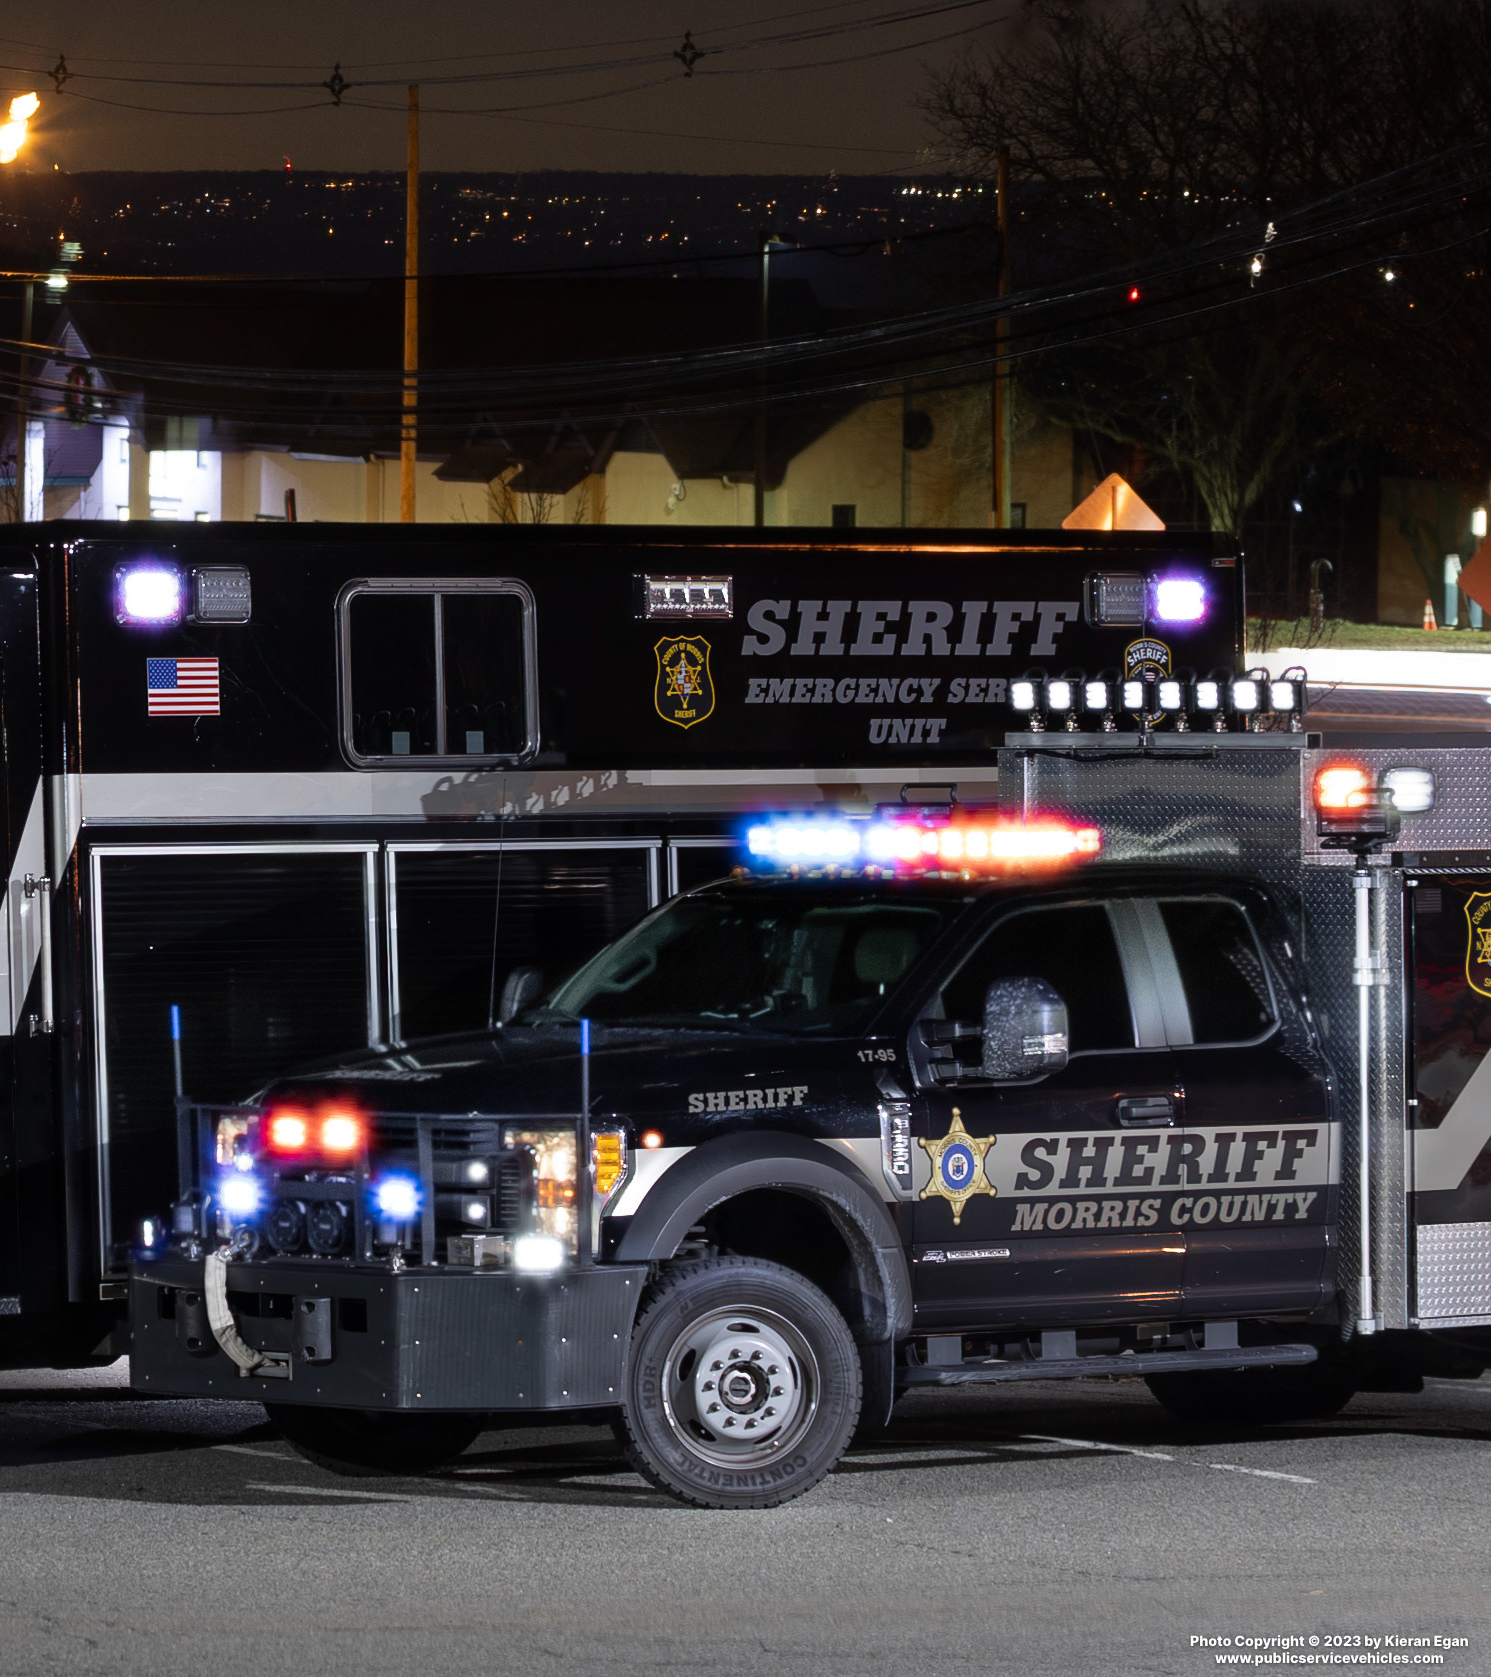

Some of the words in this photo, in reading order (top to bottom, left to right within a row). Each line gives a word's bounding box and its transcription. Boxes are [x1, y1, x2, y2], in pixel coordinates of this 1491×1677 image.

[742, 599, 1080, 656] SHERIFF
[661, 643, 679, 665] COUNTY
[678, 642, 686, 651] OF
[686, 643, 705, 664] MORRIS
[1127, 648, 1168, 666] SHERIFF
[744, 677, 940, 704] EMERGENCY
[674, 709, 696, 718] SHERIFF
[869, 718, 946, 745] UNIT
[857, 1048, 897, 1062] 17-95
[688, 1085, 808, 1114] SHERIFF
[938, 1138, 956, 1158] MORRIS
[958, 1137, 978, 1157] COUNTY
[1014, 1128, 1318, 1191] SHERIFF
[1011, 1195, 1159, 1231] MORRIS
[1169, 1191, 1318, 1225] COUNTY
[676, 1452, 807, 1488] CONTINENTAL
